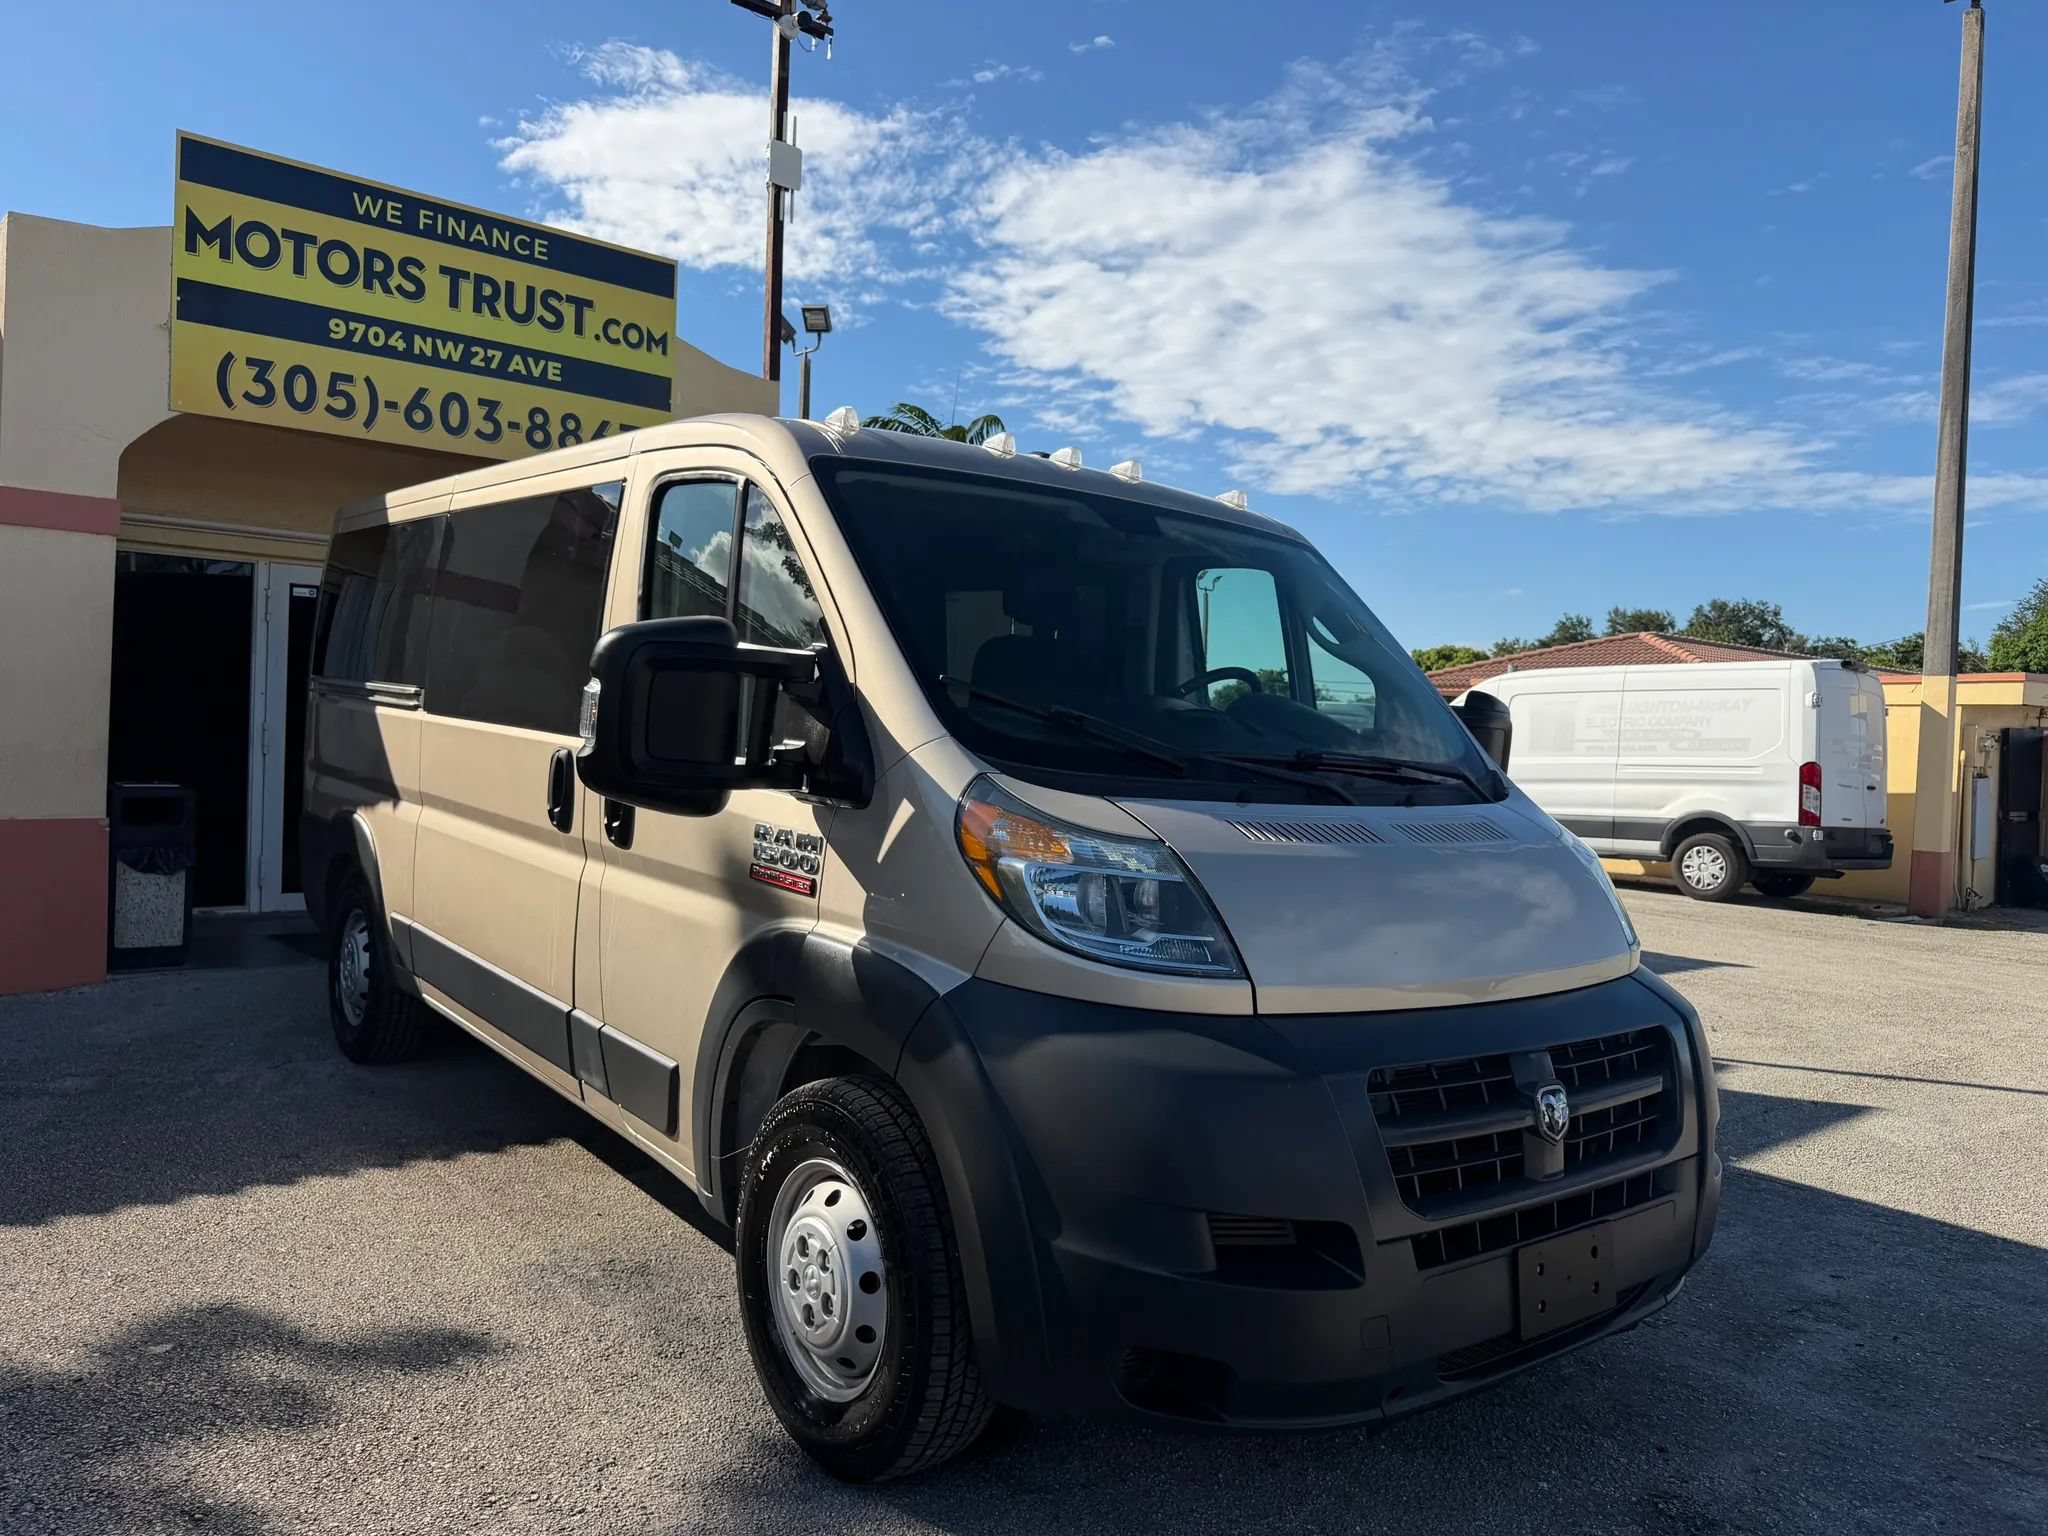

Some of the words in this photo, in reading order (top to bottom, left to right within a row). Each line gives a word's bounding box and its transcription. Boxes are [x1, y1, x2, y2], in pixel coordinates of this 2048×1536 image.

[185, 204, 427, 304] MOTORS
[352, 191, 403, 226] WE
[419, 208, 549, 262] FINANCE
[328, 317, 407, 353] 9704
[413, 333, 464, 363] NW
[470, 345, 502, 370] 27
[508, 355, 563, 383] AVE
[216, 350, 642, 451] (305)-603-88
[1648, 714, 1714, 729] COMPANY
[754, 823, 825, 857] RAM
